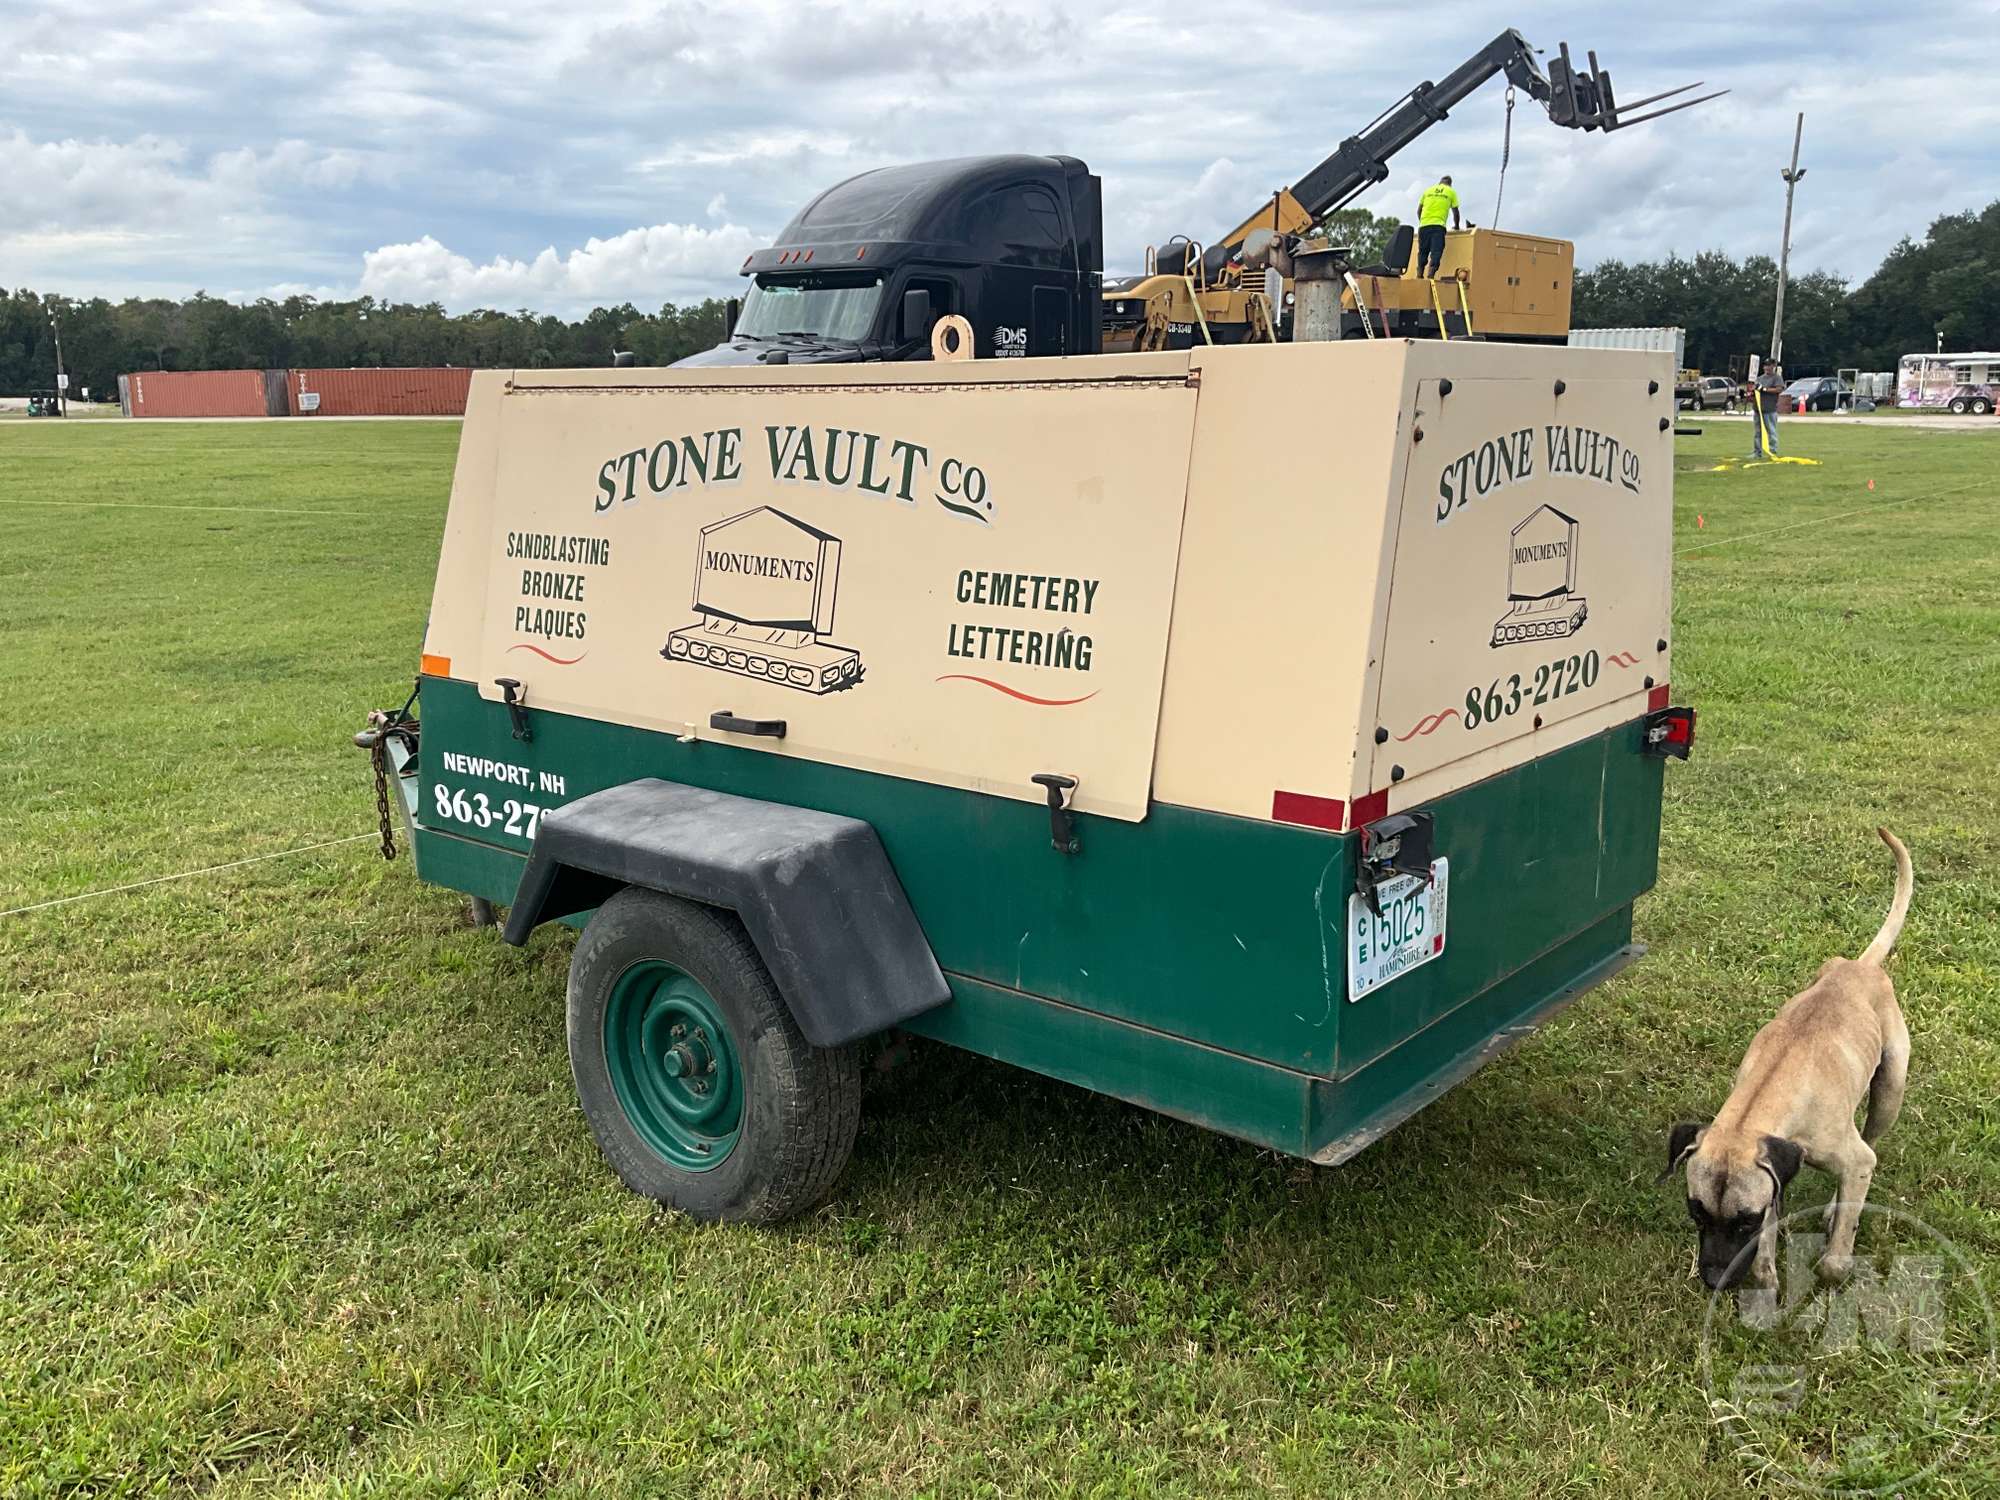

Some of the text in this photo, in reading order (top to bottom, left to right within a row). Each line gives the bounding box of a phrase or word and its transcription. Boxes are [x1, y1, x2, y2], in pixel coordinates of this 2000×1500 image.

[1002, 327, 1027, 345] DM5
[594, 425, 994, 514] STONE VAULT CO.
[1436, 425, 1642, 524] STONE VAULT CO.
[506, 531, 610, 567] SANDBLASTING
[704, 549, 815, 584] MONUMENTS
[1513, 540, 1568, 566] MONUMENTS
[520, 569, 585, 603] BRONZE
[955, 568, 1100, 616] CEMETERY
[514, 606, 586, 641] PLAQUES
[946, 622, 1093, 672] LETTERING
[1463, 648, 1600, 731] 863-2720
[443, 751, 566, 796] NEWPORT, NH
[434, 783, 553, 840] 863-27
[1389, 879, 1405, 895] FREE
[1371, 895, 1426, 959] 15025
[1378, 945, 1422, 981] HAMPSHIRE
